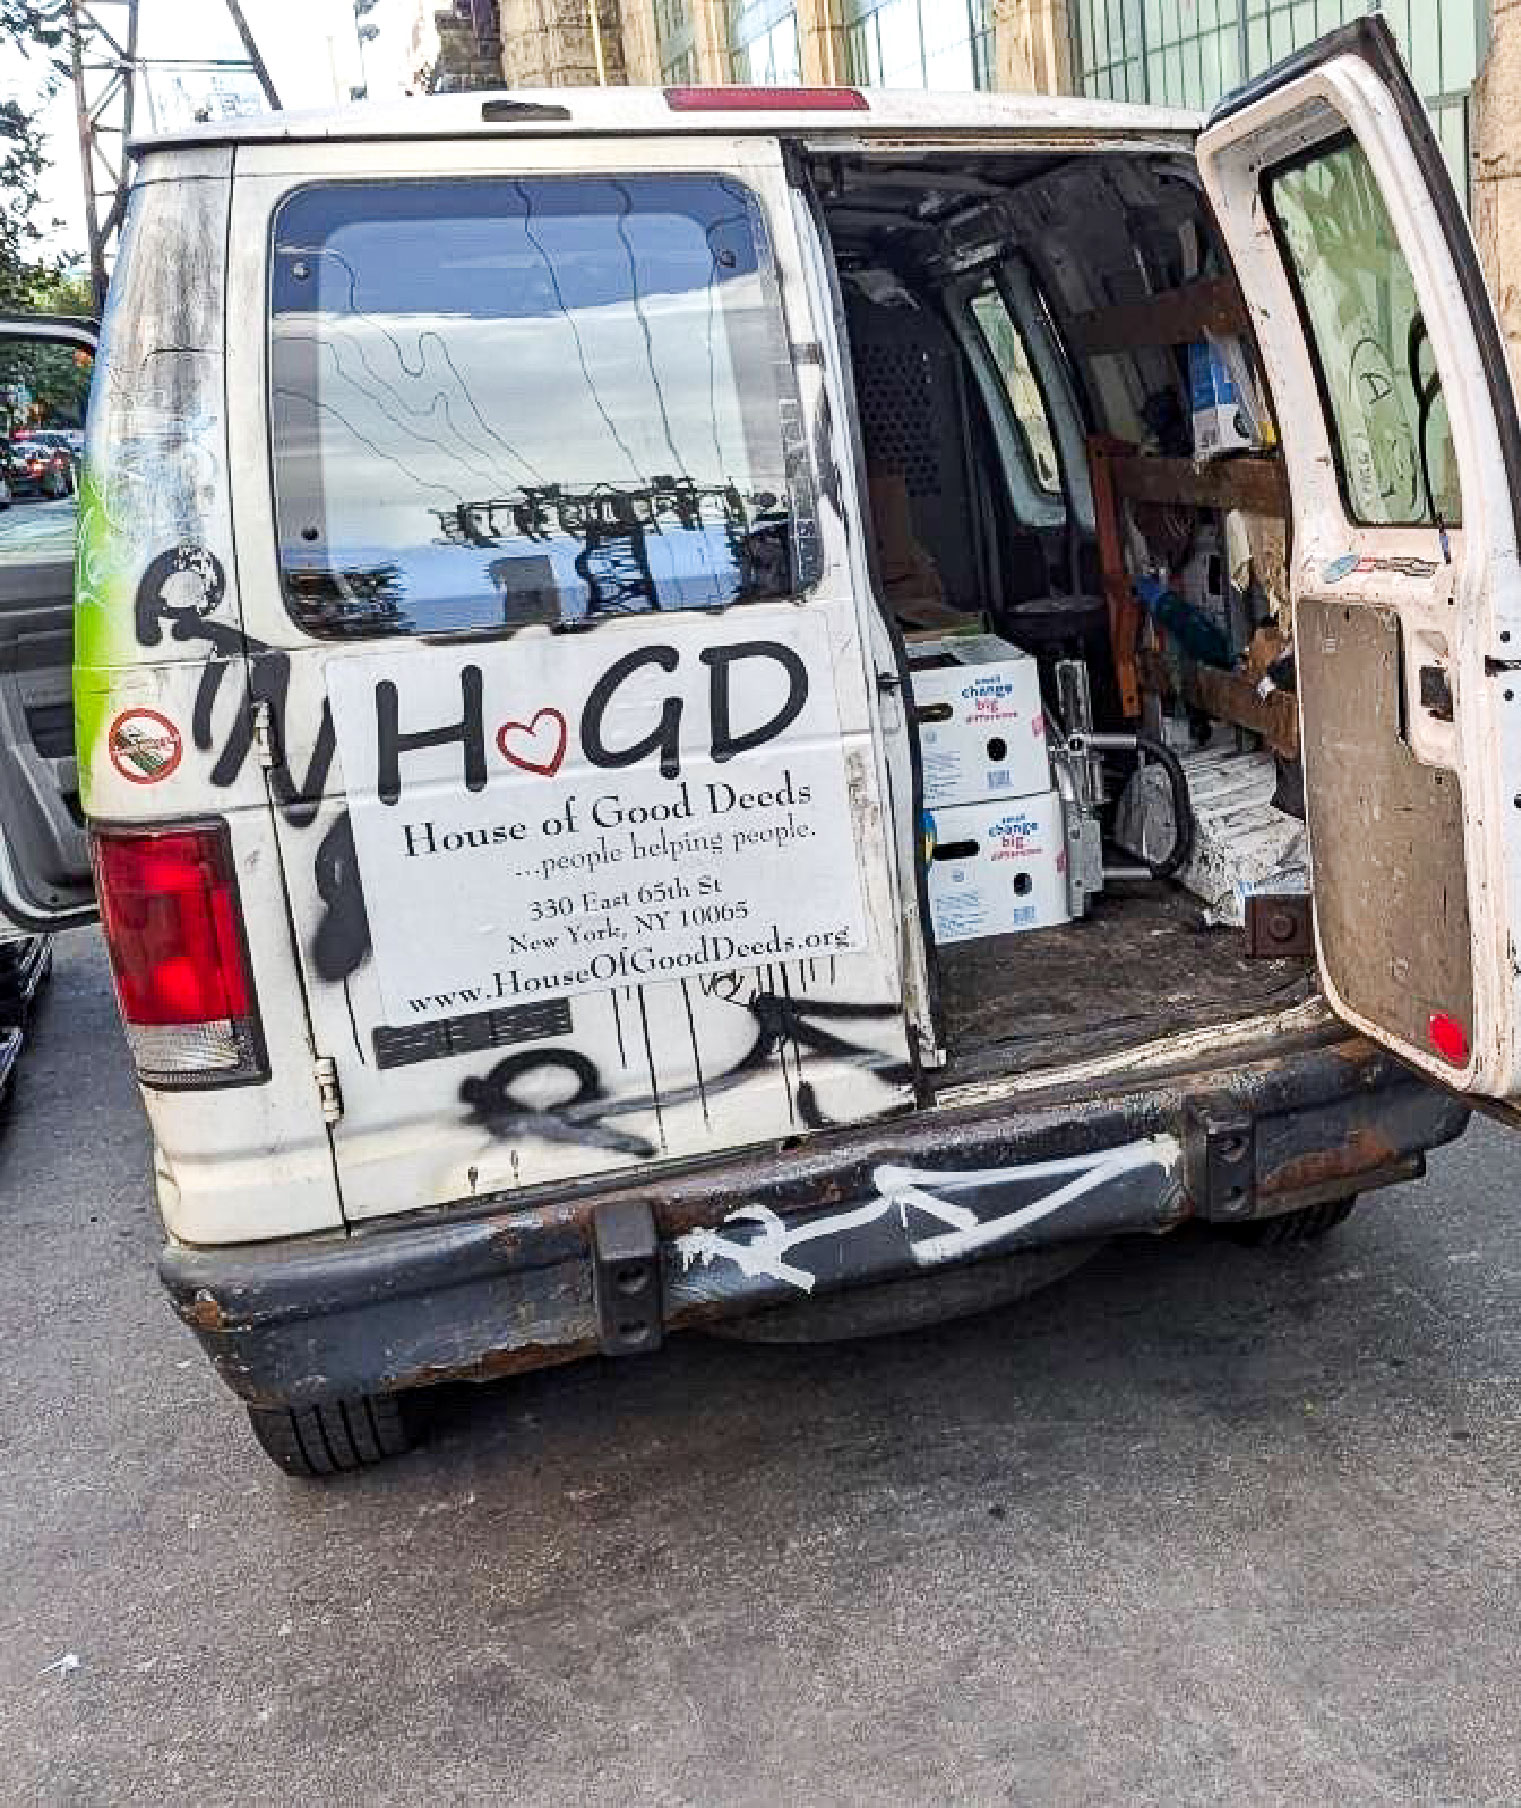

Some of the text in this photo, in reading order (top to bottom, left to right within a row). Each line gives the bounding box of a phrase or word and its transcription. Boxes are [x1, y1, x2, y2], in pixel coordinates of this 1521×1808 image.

[402, 769, 812, 857] House of Good Deeds
[630, 827, 723, 862] helping
[732, 812, 817, 854] people.
[529, 875, 723, 921] 330 East 65th St
[508, 899, 748, 955] New York, NY 10065
[408, 924, 851, 1013] www.HouseOfGoodDeeds.org
